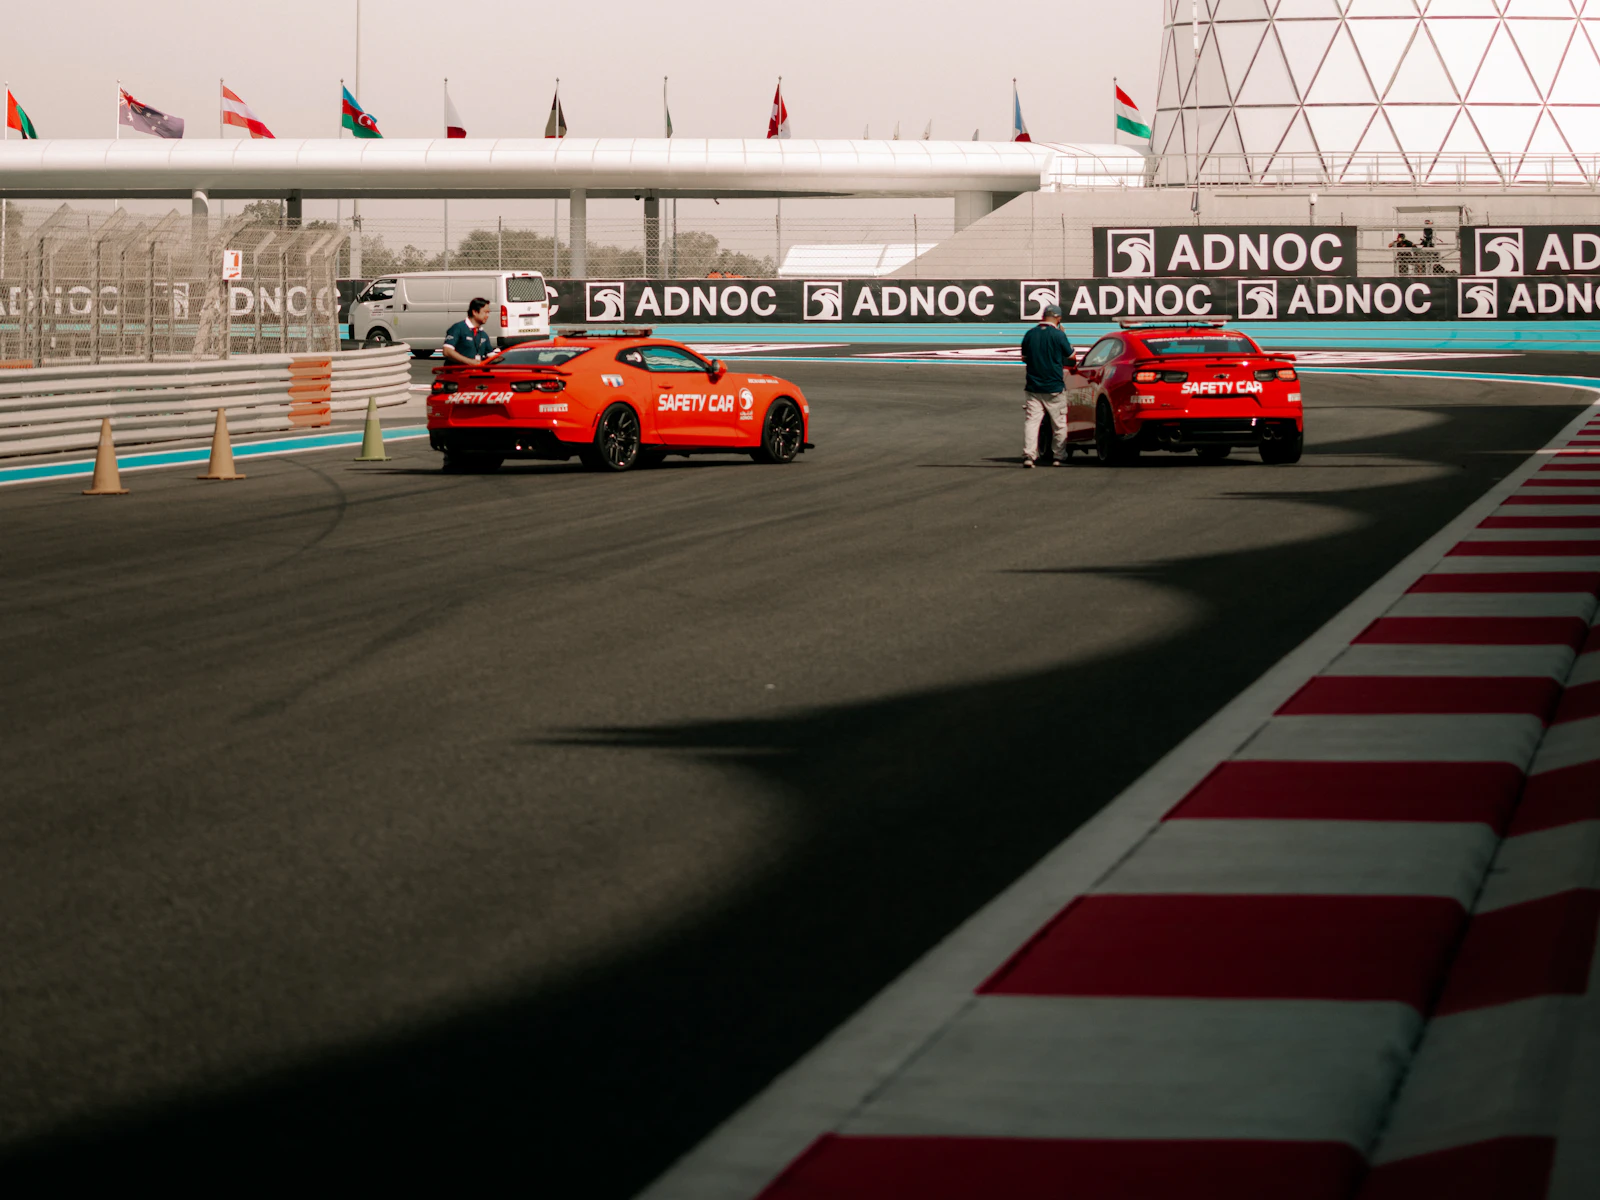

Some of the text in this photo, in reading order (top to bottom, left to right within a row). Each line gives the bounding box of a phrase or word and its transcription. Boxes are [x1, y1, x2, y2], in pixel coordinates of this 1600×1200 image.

[1168, 232, 1343, 272] ADNOC
[1536, 233, 1600, 271] AD
[0, 285, 119, 316] DNOC
[635, 286, 777, 317] ADNOC
[852, 286, 995, 317] ADNOC
[1070, 284, 1212, 316] ADNOC
[1287, 283, 1432, 314] ADNOC
[1507, 282, 1600, 314] ADN
[445, 392, 515, 404] SAFETY CAR
[657, 393, 735, 413] SAFETY CAR
[1181, 381, 1263, 395] SAFETY CAR
